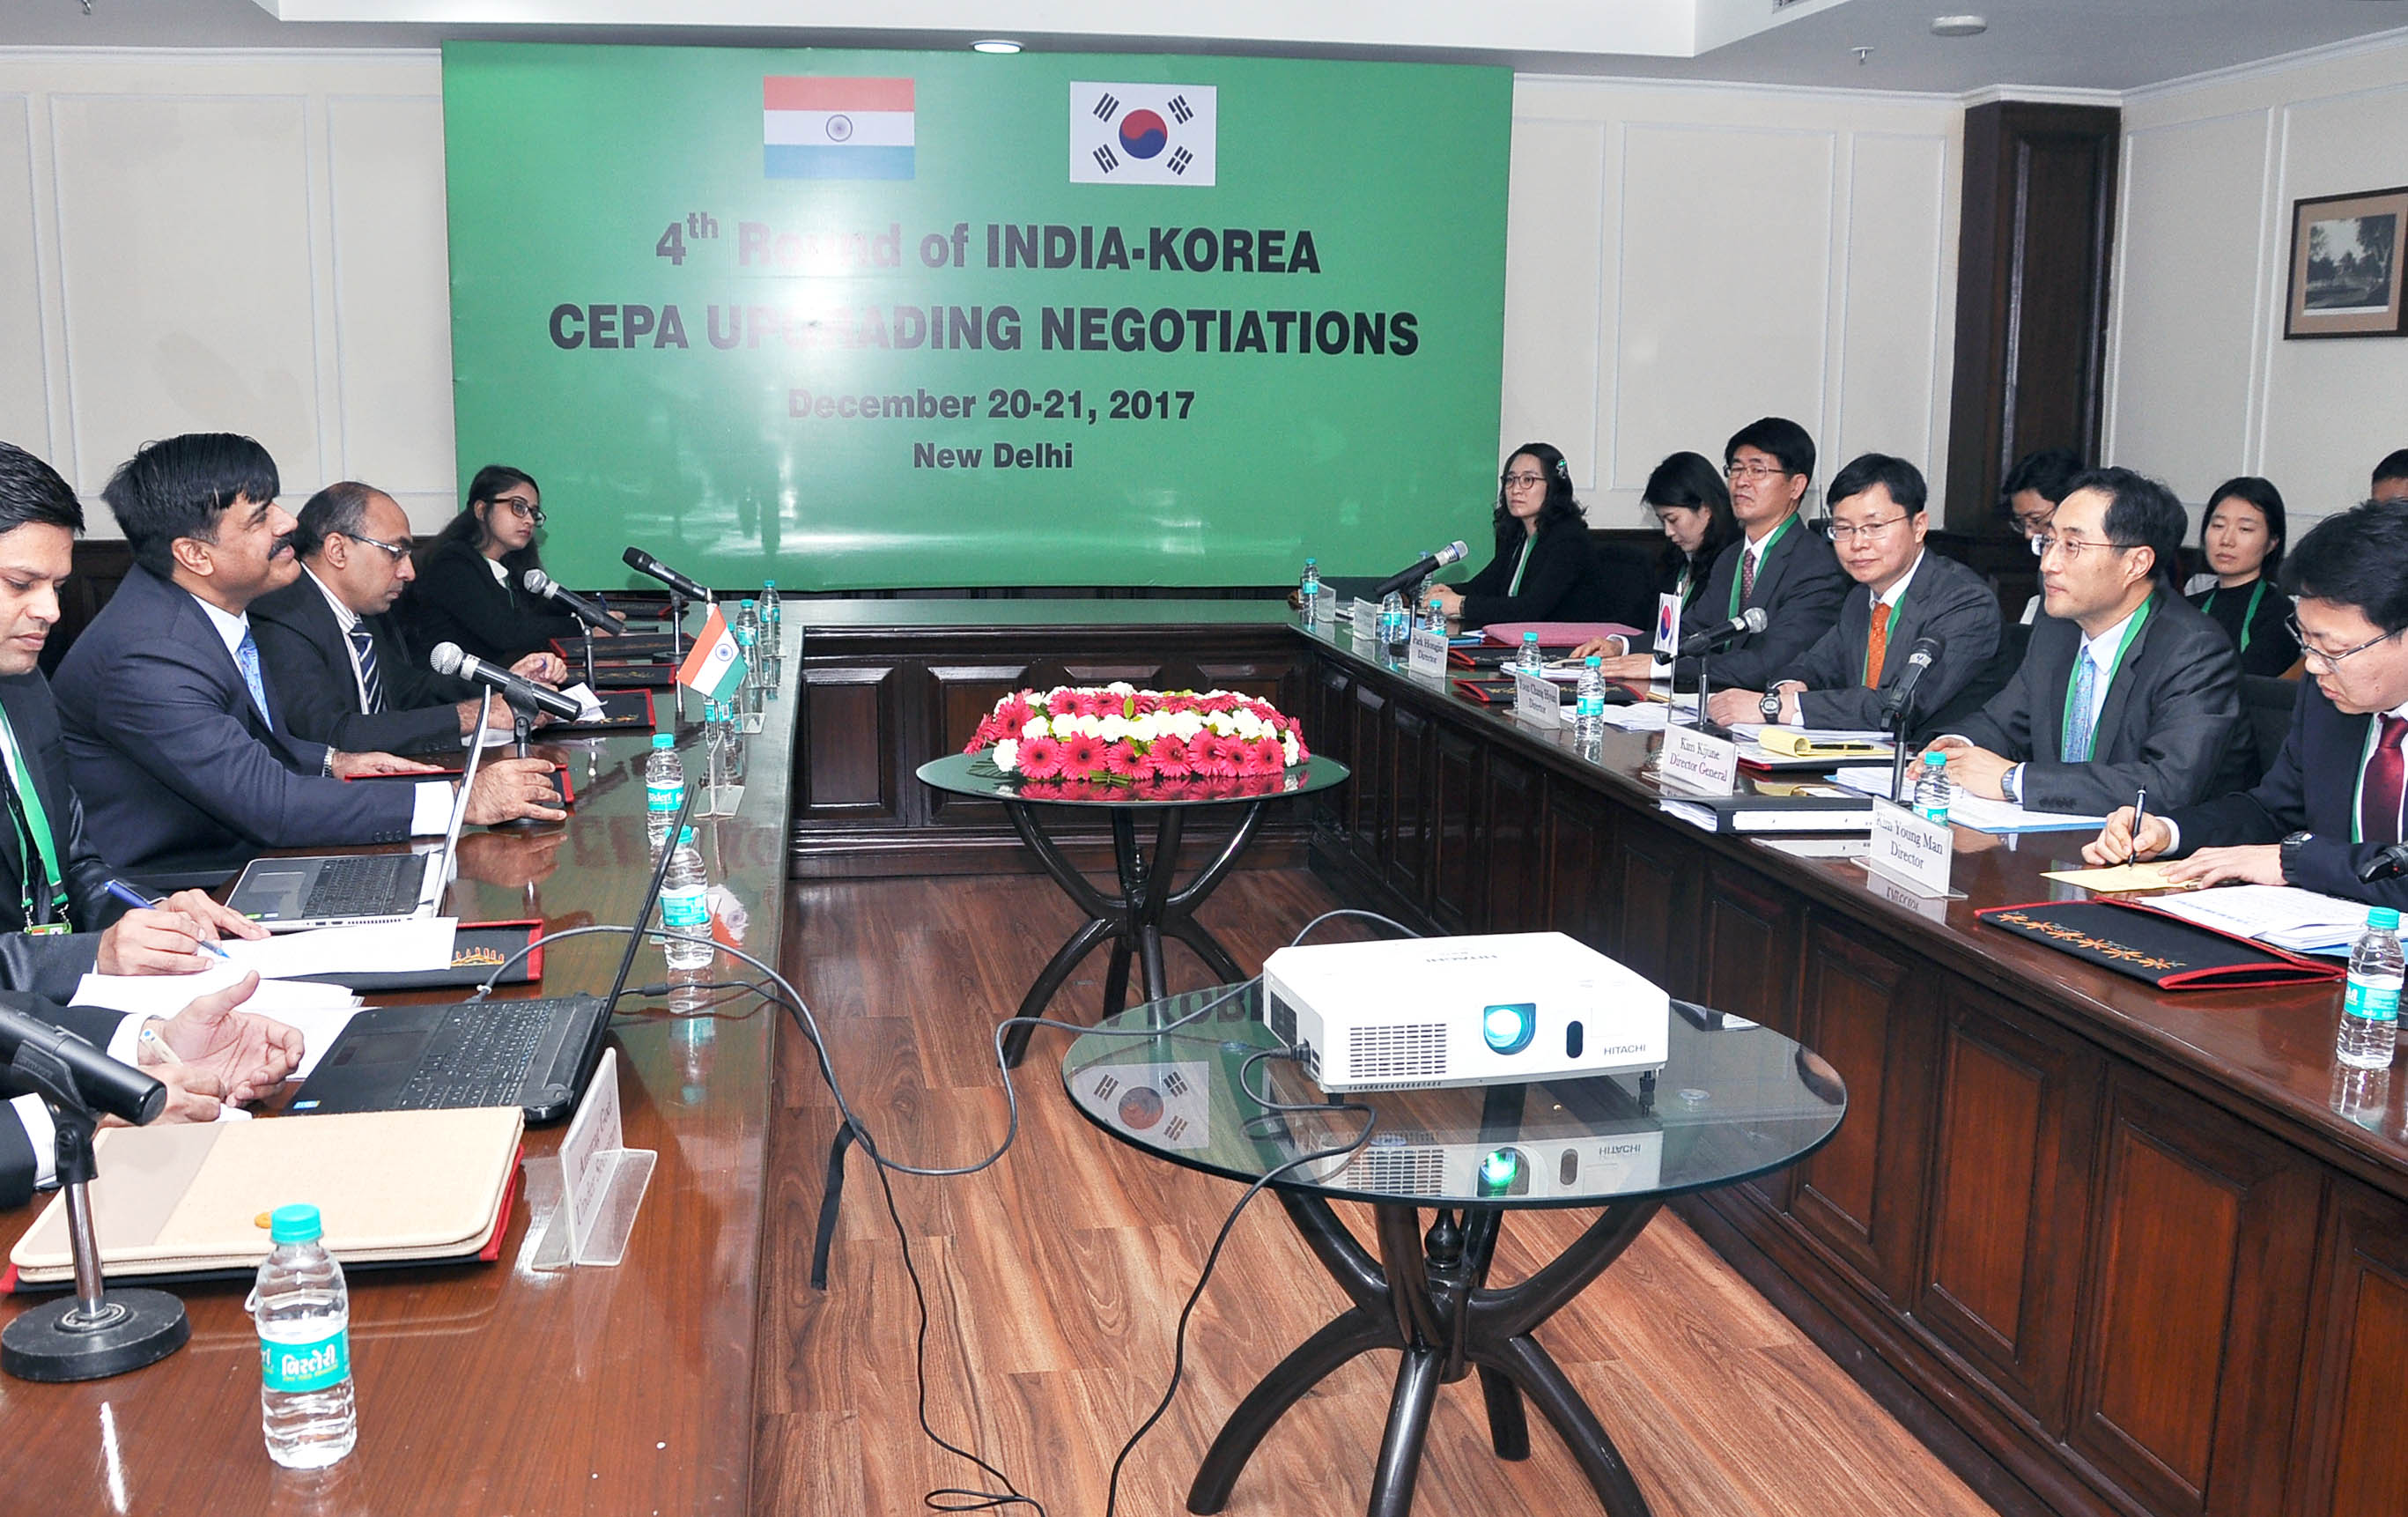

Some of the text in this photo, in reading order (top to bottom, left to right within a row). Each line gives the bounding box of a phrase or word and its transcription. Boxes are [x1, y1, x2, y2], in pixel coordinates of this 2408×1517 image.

[656, 211, 1321, 274] 4th Round of INDIA-KOREA
[549, 303, 689, 351] CEPA
[1041, 307, 1419, 356] NEGOTIATIONS
[788, 388, 1195, 425] December 20-21, 2017
[913, 442, 1073, 469] New Delhi
[1670, 752, 1727, 782] Director General
[1895, 819, 1921, 847] Young
[1923, 832, 1944, 855] Man
[1890, 840, 1924, 870] Director
[1604, 1043, 1646, 1055] HITACHI
